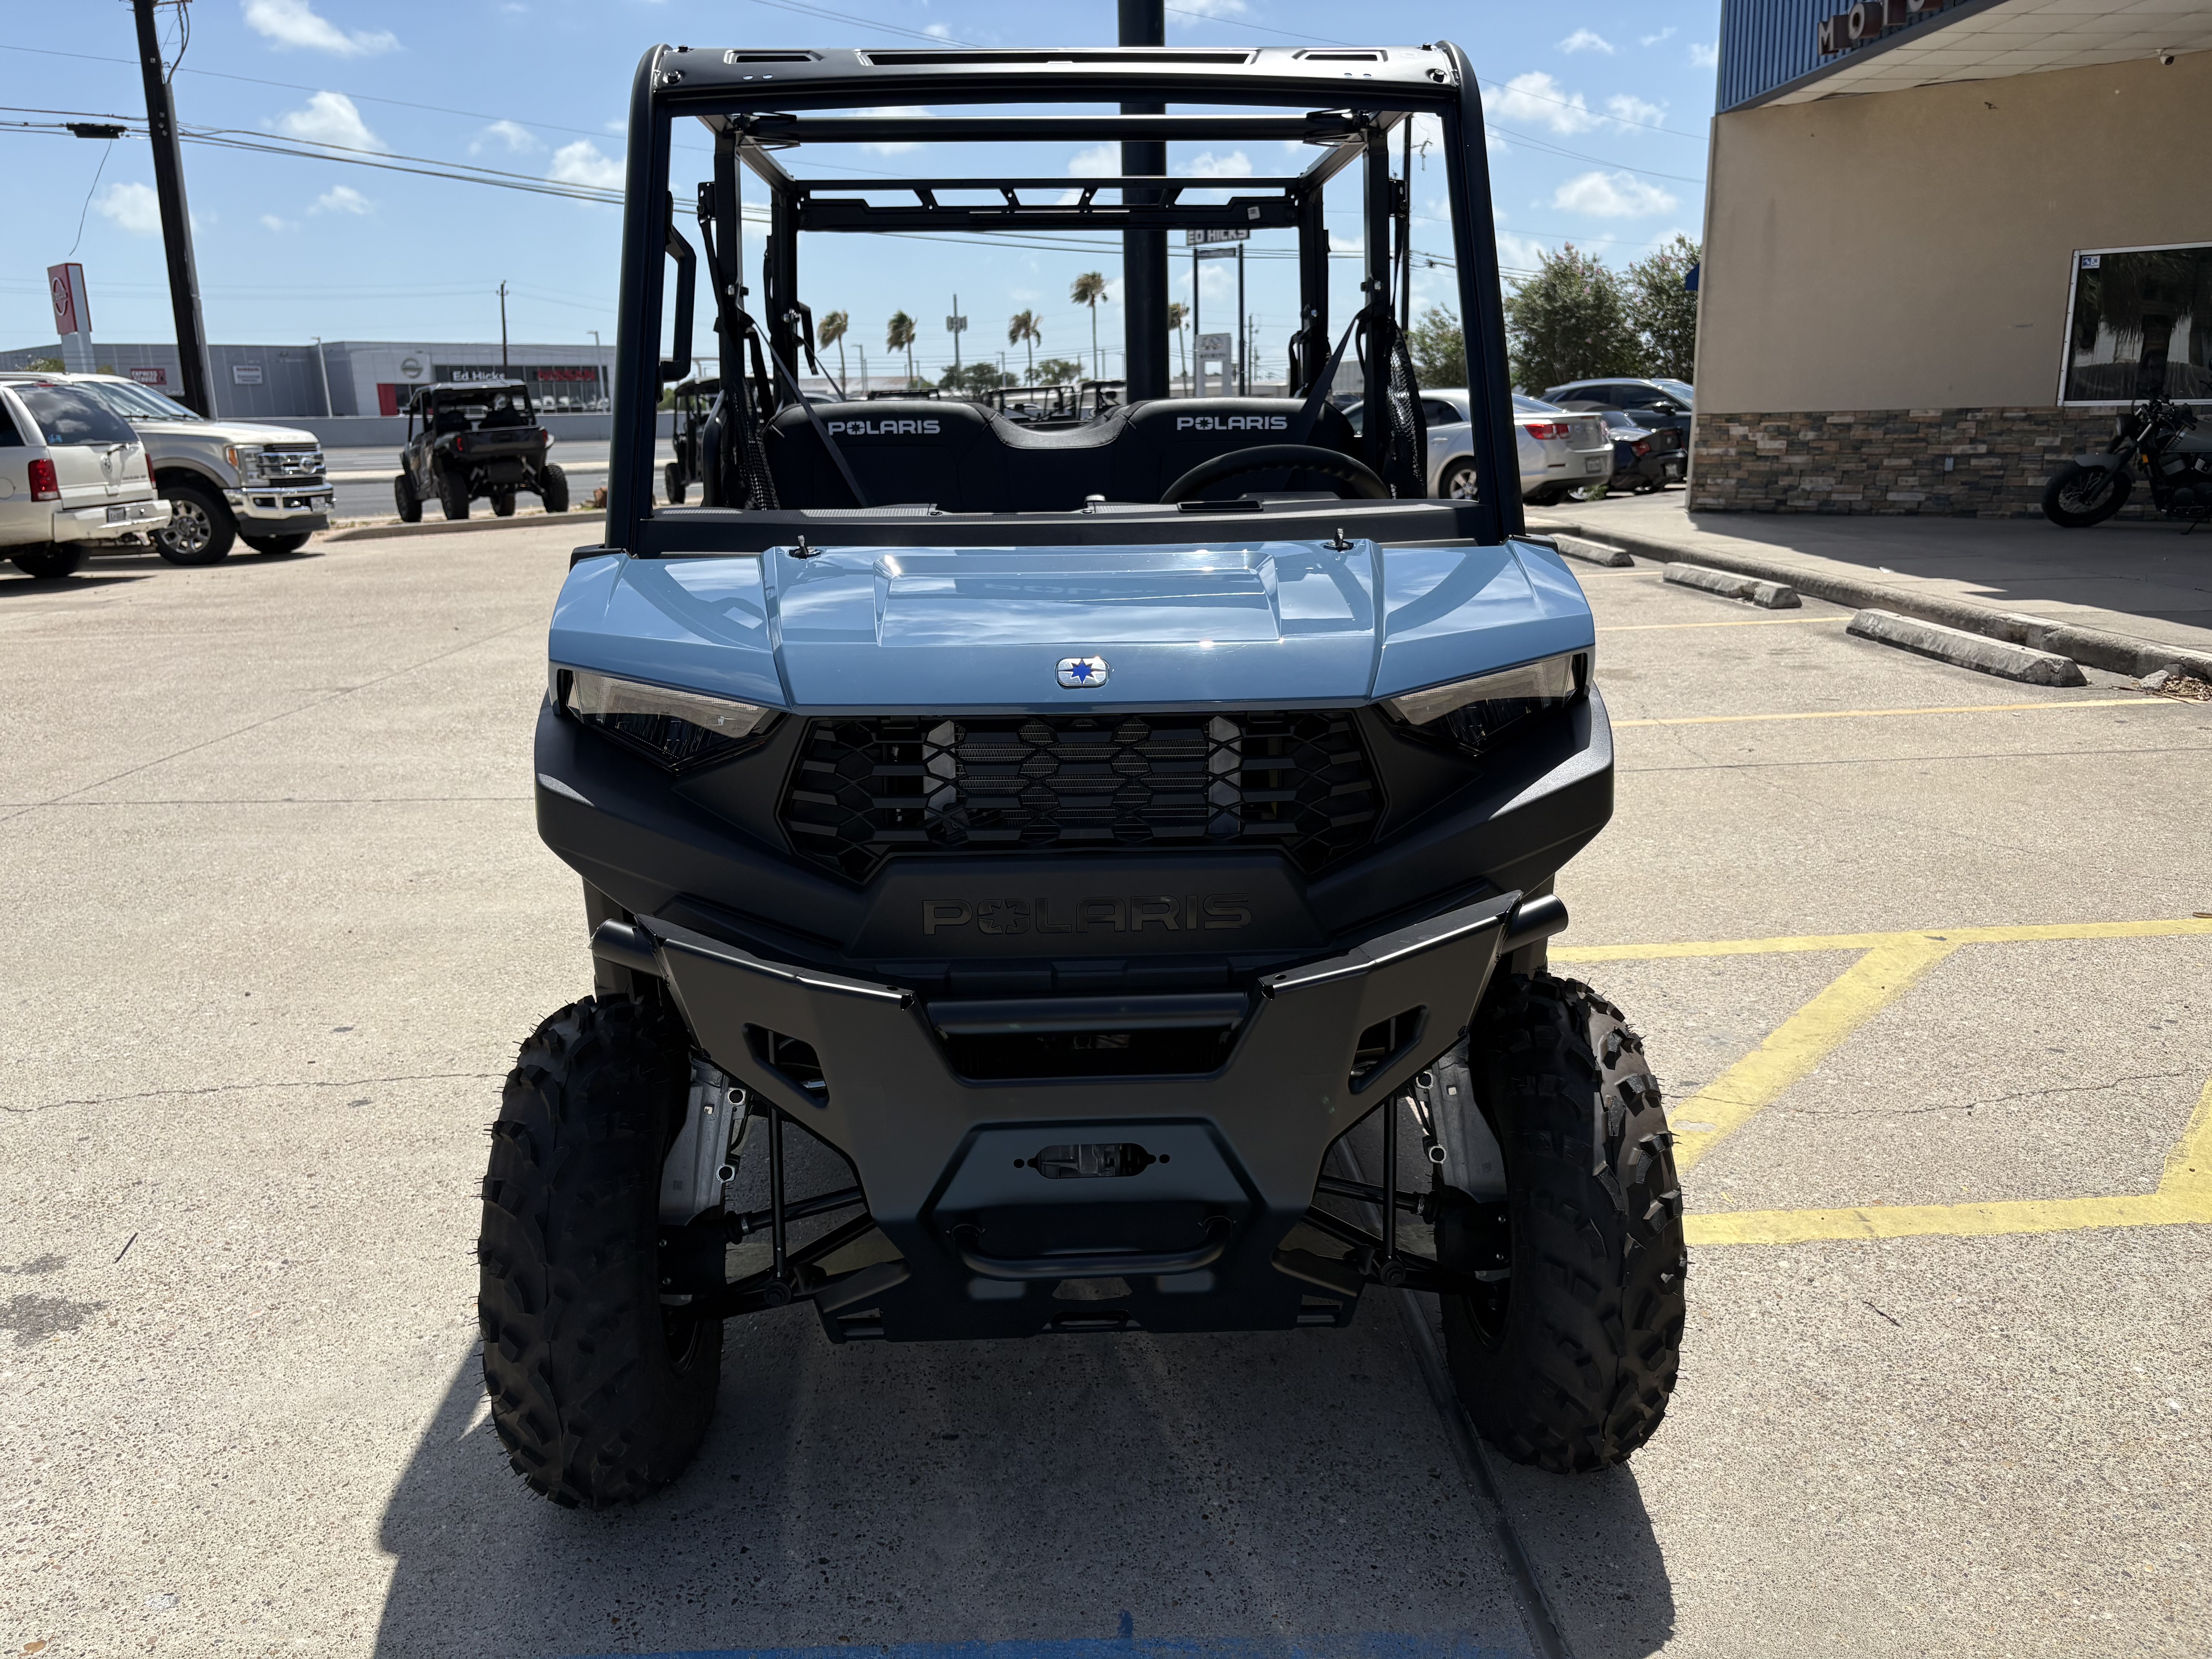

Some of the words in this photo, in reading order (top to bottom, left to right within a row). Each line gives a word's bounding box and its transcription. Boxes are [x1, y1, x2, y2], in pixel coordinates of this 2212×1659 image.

[1207, 229, 1247, 241] HICKS
[453, 371, 468, 381] Ed
[472, 371, 505, 381] Hicks
[538, 370, 595, 381] NISSAN
[828, 420, 940, 436] POLARIS
[1177, 417, 1288, 430] POLARIS
[922, 893, 1252, 935] POLARIS
